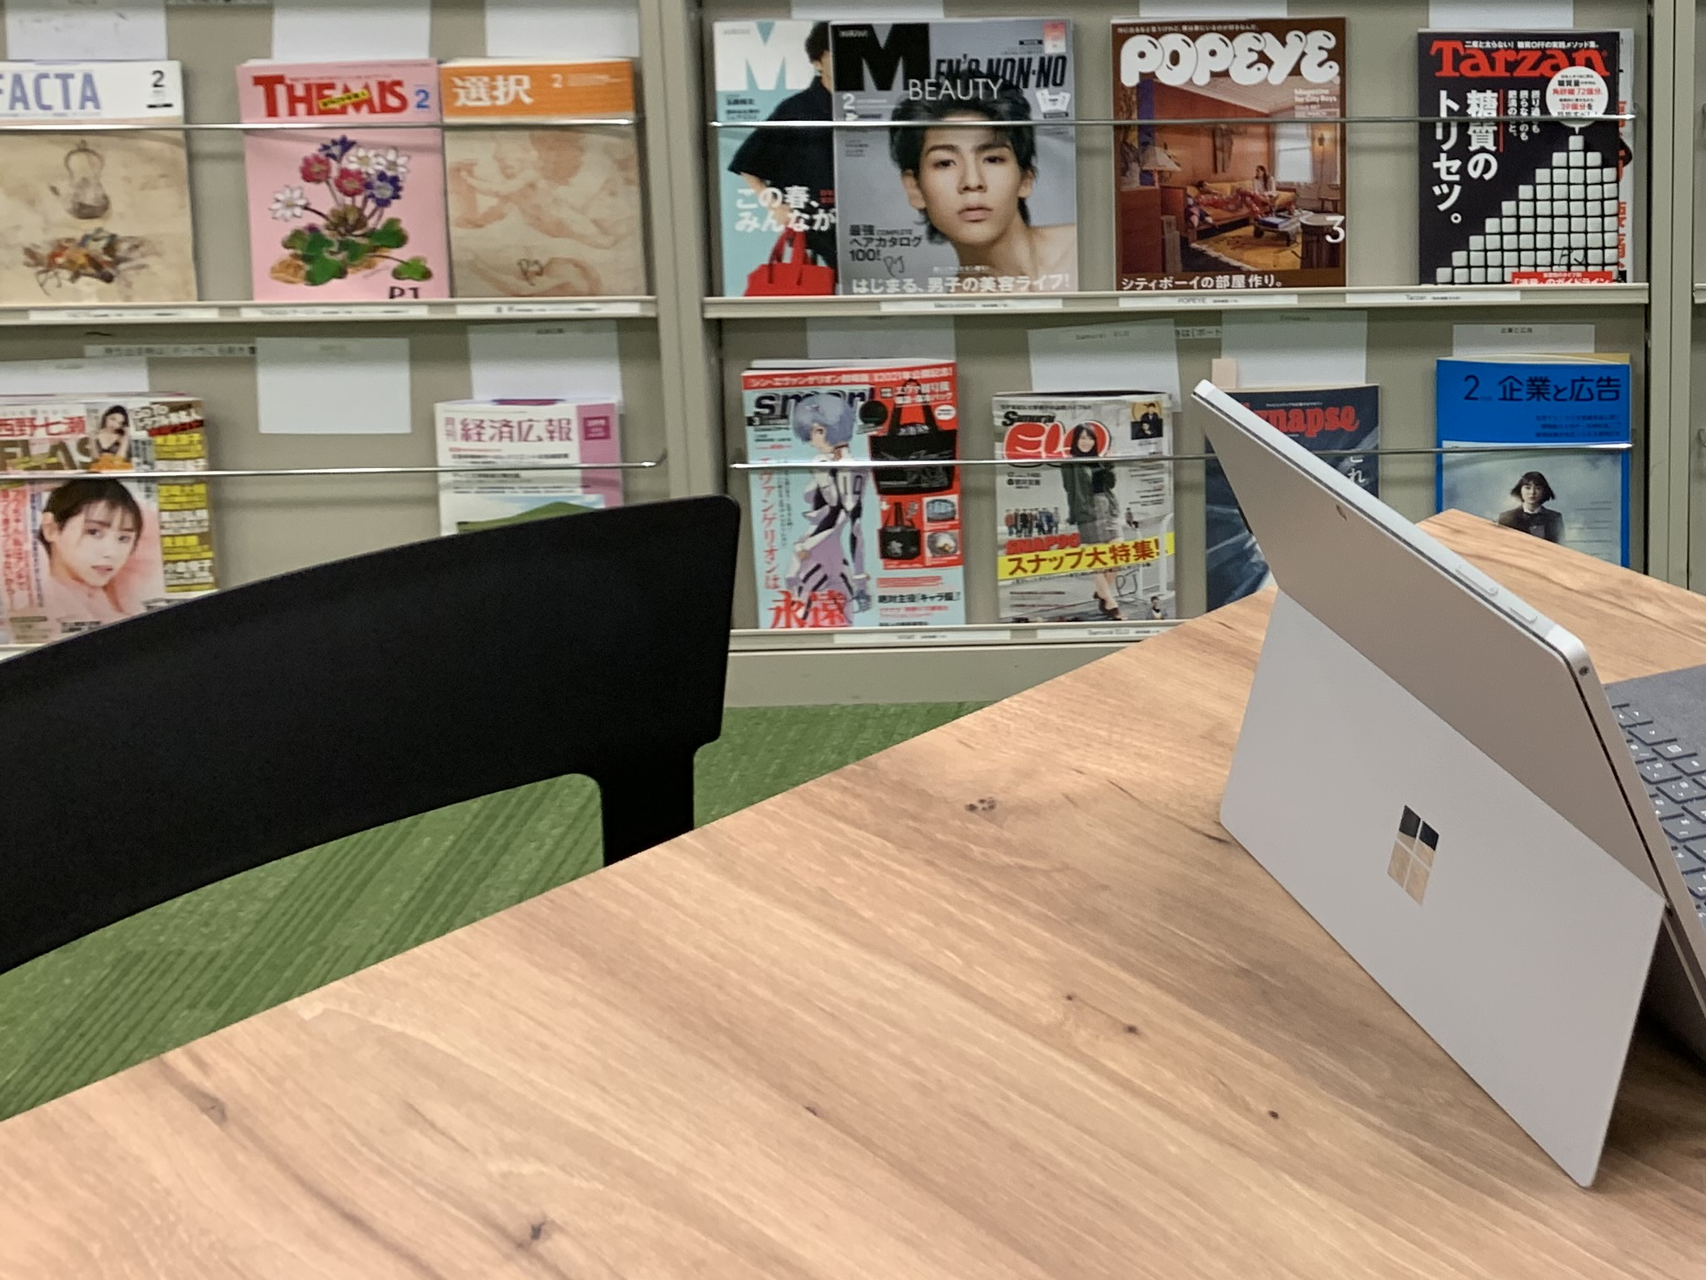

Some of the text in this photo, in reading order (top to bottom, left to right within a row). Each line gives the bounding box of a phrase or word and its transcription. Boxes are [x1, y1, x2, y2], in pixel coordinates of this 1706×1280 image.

[1517, 40, 1600, 49] 糖質OFFの実践メソッド集。
[1120, 29, 1340, 87] POPEYE
[1429, 40, 1610, 78] Tarzan
[152, 70, 166, 88] 2
[452, 74, 562, 107] 選択 2
[908, 78, 1004, 101] BEAUTY
[253, 75, 408, 118] THEMIS
[414, 89, 429, 109] 2
[843, 93, 856, 109] 2
[1466, 90, 1498, 180] 糖質の
[1432, 90, 1462, 224] トリセツ。
[735, 186, 819, 209] この春、
[849, 225, 875, 236] 最強
[1325, 215, 1345, 244] 3
[849, 236, 922, 248] ヘアカタログ
[849, 248, 881, 262] 100!
[852, 273, 1071, 294] はじまる、男子の美容ライフ!
[1121, 274, 1283, 291] シティボーイの部屋作り。
[1463, 374, 1622, 403] 2 企業と広告
[460, 418, 573, 442] 経済広報
[1008, 538, 1159, 575] スナップ大特集!
[1115, 570, 1139, 597] PJ
[770, 590, 851, 628] 永遠
